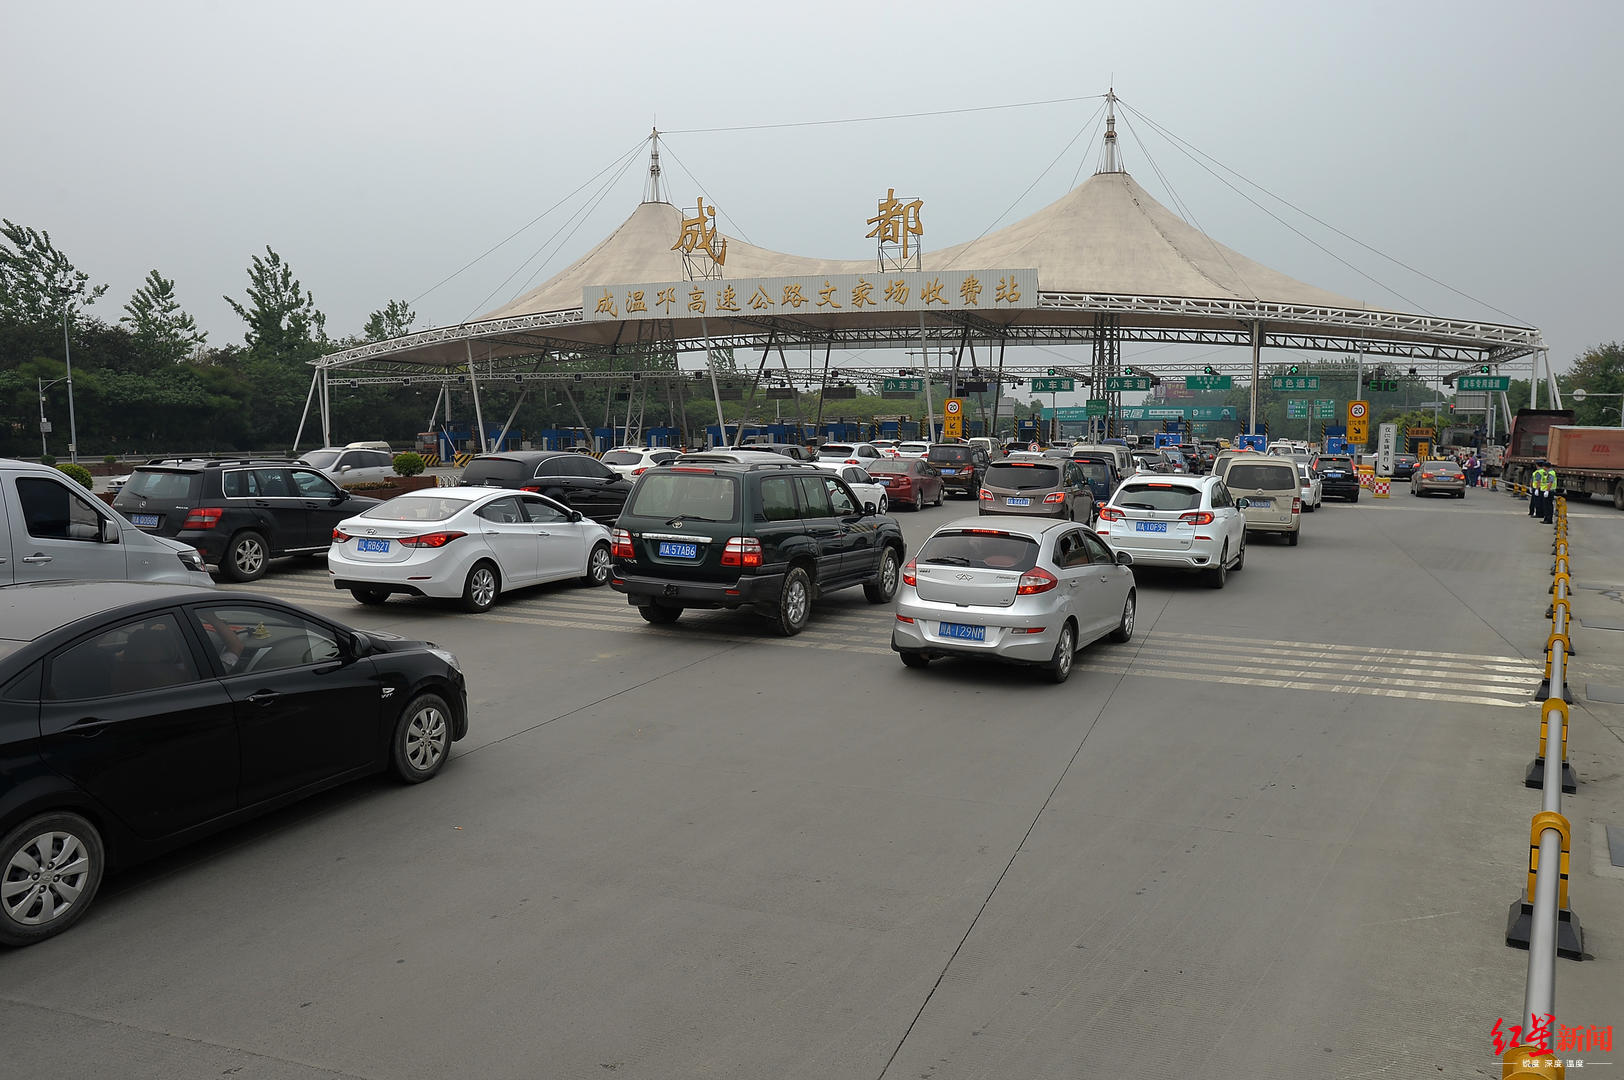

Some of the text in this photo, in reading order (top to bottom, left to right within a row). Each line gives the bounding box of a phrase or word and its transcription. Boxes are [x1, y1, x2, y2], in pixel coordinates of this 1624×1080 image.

[594, 274, 1022, 319] 成温邛高速公路文家场收费站
[886, 380, 921, 390] 小车道
[1035, 379, 1071, 390] 小车道
[1109, 379, 1147, 390] 小车道
[1273, 378, 1318, 389] 绿色通道
[1369, 380, 1398, 392] ETC
[949, 403, 957, 411] 20
[1353, 406, 1363, 414] 20
